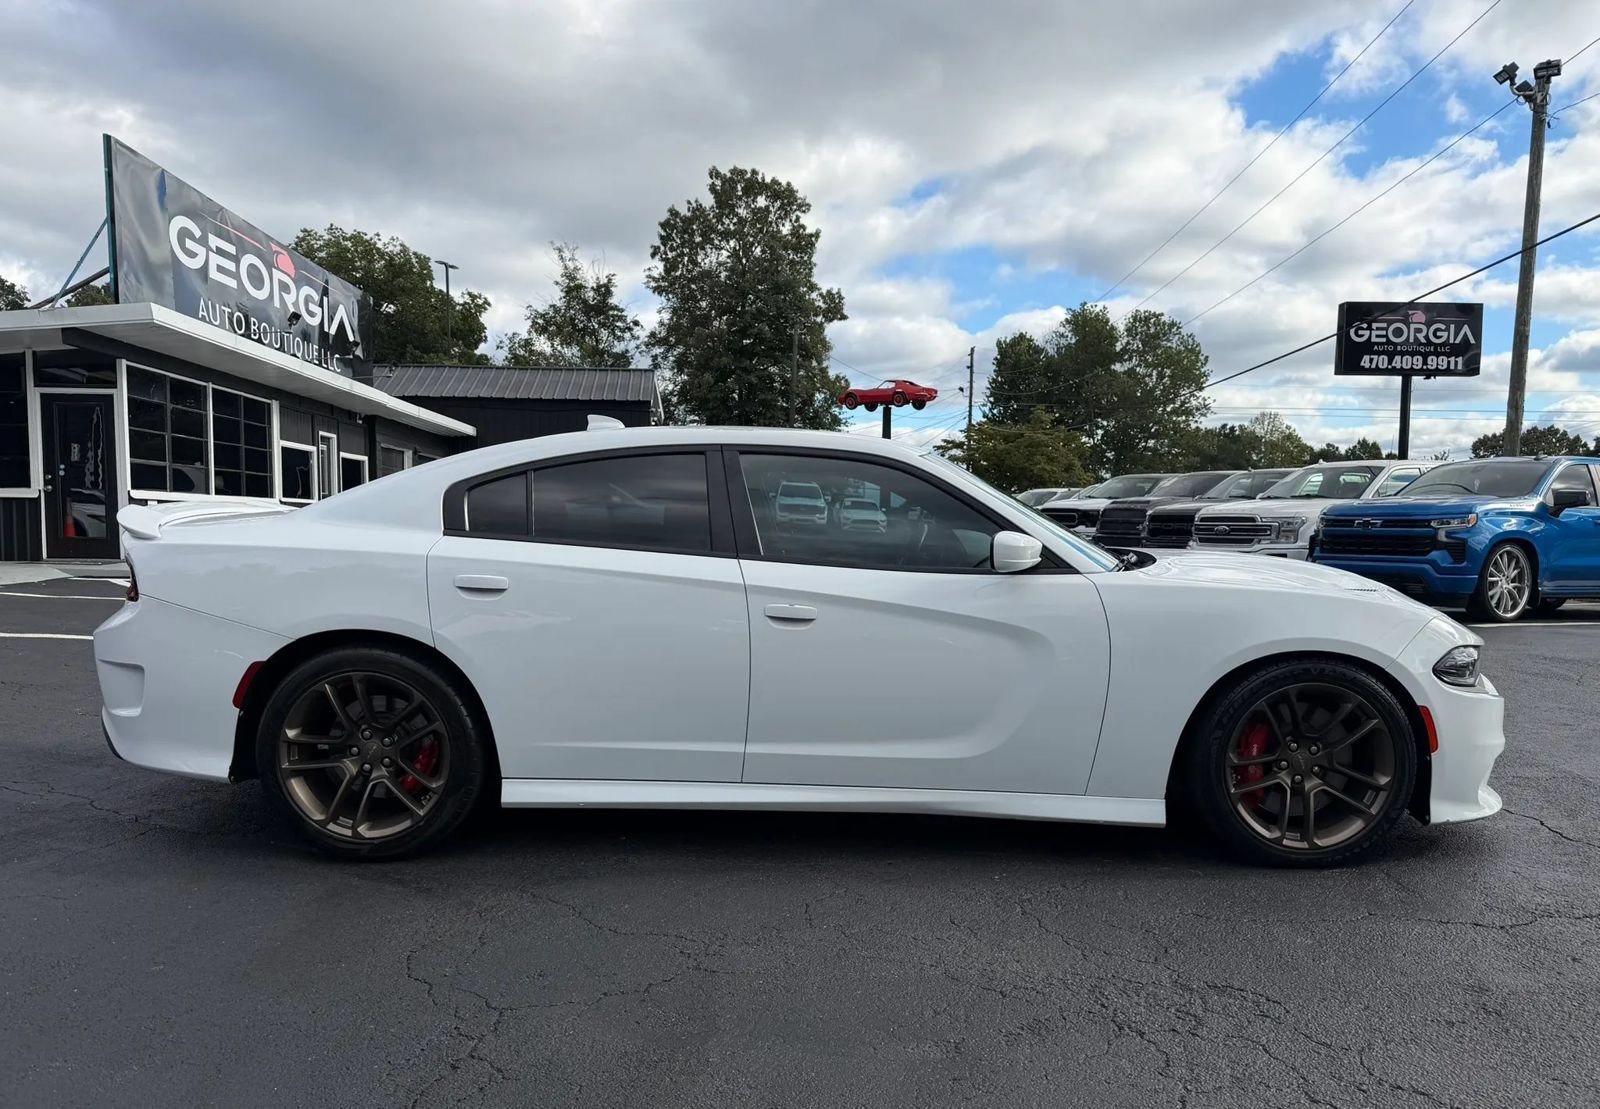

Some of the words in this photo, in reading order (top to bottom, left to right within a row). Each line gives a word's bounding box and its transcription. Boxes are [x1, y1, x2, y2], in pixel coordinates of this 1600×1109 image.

[169, 214, 354, 343] GEORGIA
[198, 297, 246, 335] AUTO
[250, 320, 319, 364] BOUTIQUE
[320, 346, 342, 373] LLC
[1349, 322, 1476, 344] GEORGIA
[1396, 345, 1435, 353] BOUTIQUE
[1360, 354, 1463, 370] 470.409.9911
